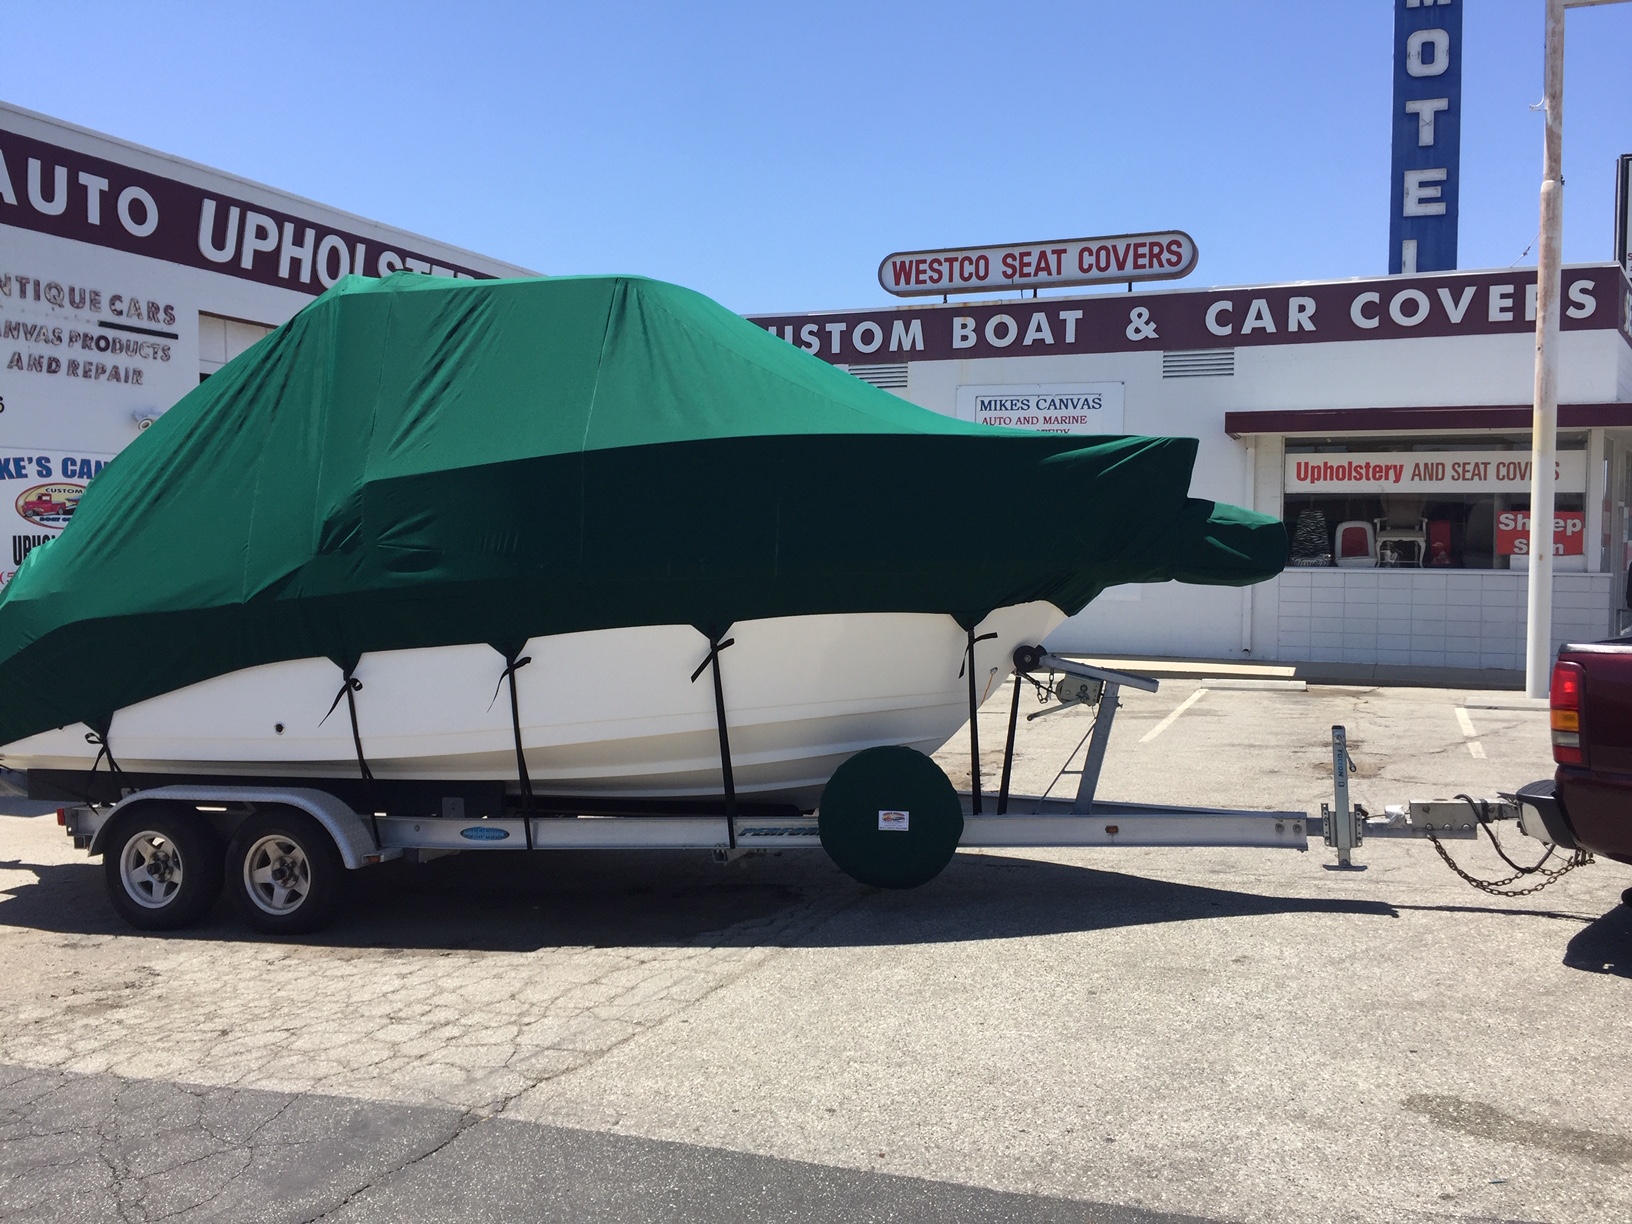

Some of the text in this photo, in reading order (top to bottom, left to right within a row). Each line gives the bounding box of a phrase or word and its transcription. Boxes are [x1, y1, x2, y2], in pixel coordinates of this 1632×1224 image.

[1402, 0, 1450, 273] OTEL
[891, 239, 1184, 287] WESTCO SEAT COVERS
[109, 294, 176, 326] CARS
[952, 310, 1083, 350] BOAT
[1125, 306, 1159, 342] &
[1205, 296, 1317, 337] CAR
[0, 320, 171, 362] NVAS PRODUCTS
[7, 351, 144, 386] AND REPAIR
[979, 397, 1103, 412] MIKES CANVAS
[982, 415, 1088, 426] AUTO AND MARINE
[1296, 461, 1560, 484] Upholstery AND SEAT COVS
[45, 487, 83, 495] CUSTOM
[1498, 513, 1582, 536] Shep
